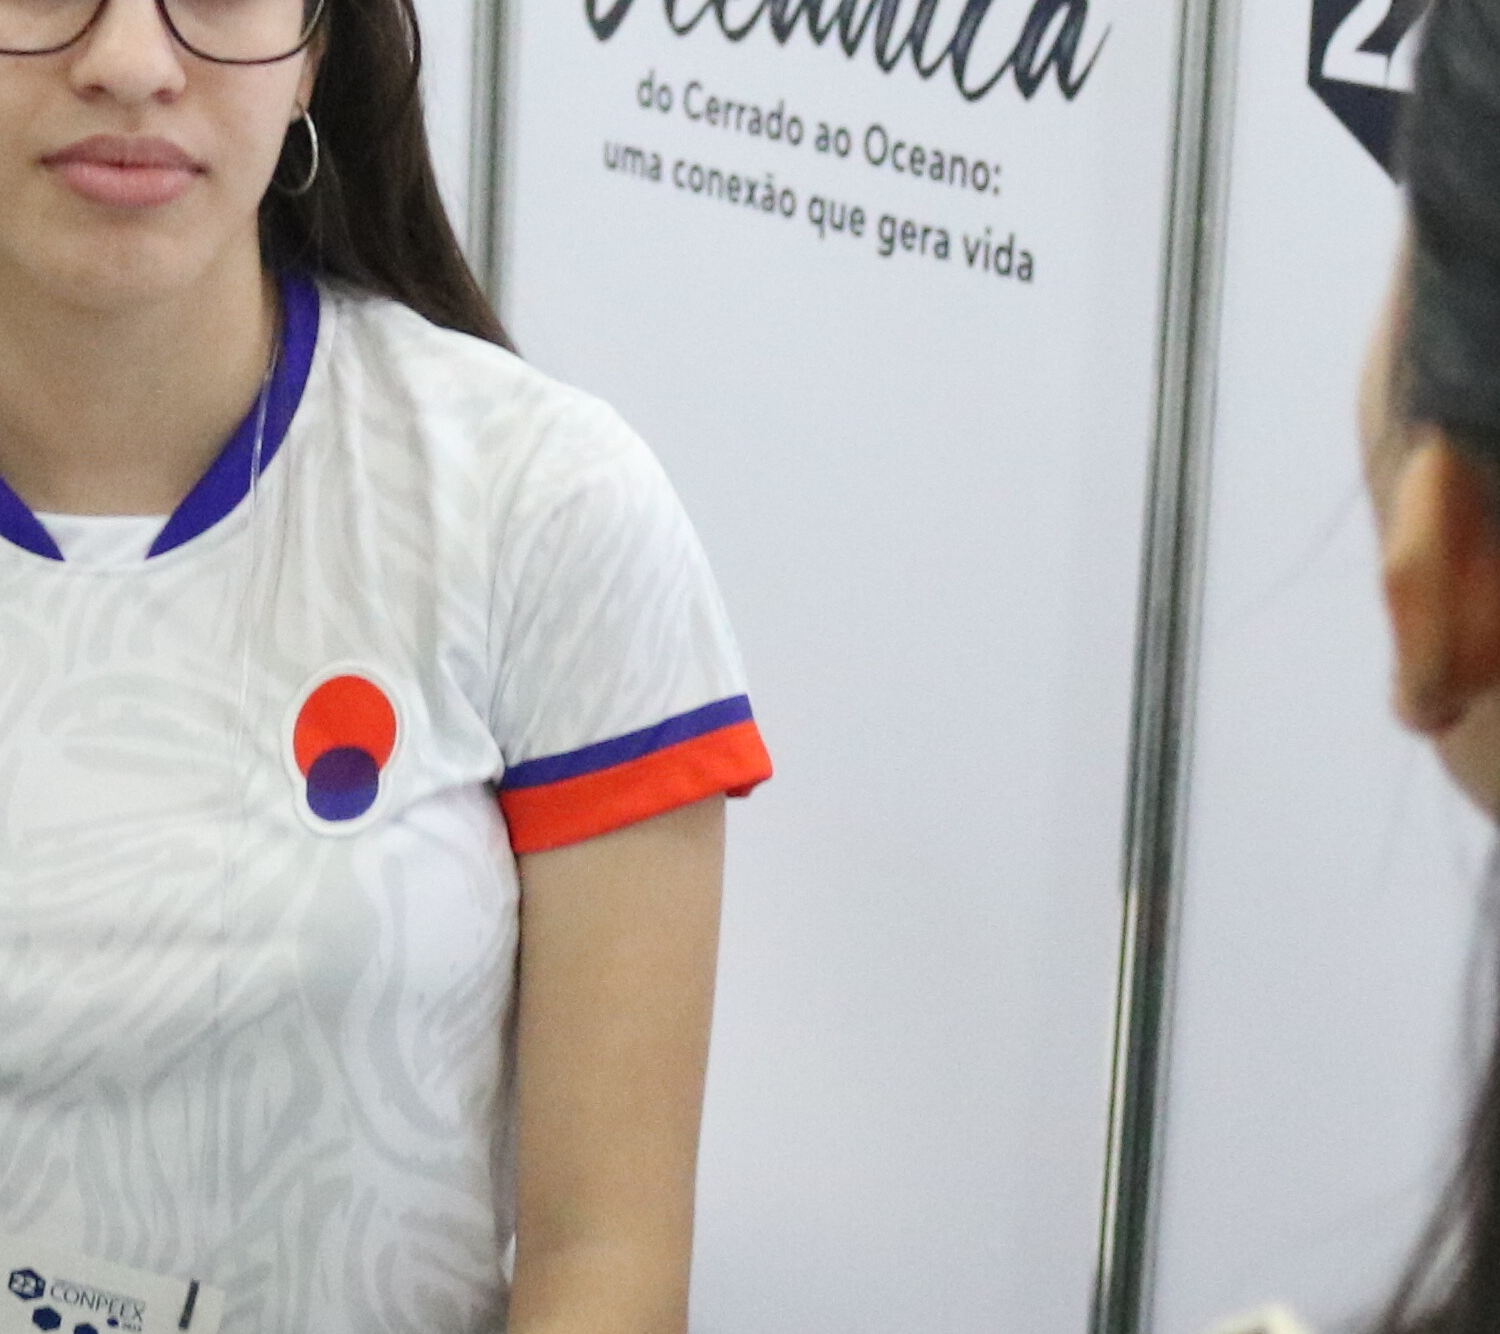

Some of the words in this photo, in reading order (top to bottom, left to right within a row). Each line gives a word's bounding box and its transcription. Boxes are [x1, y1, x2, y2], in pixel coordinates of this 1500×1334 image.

[637, 71, 674, 113] do
[683, 83, 802, 148] Cerrado
[814, 121, 853, 159] ao
[865, 124, 1001, 196] Oceano:
[603, 135, 663, 183] uma
[672, 158, 796, 220] conexão
[806, 193, 866, 239] que
[877, 215, 951, 261] gera
[964, 228, 1036, 284] vida
